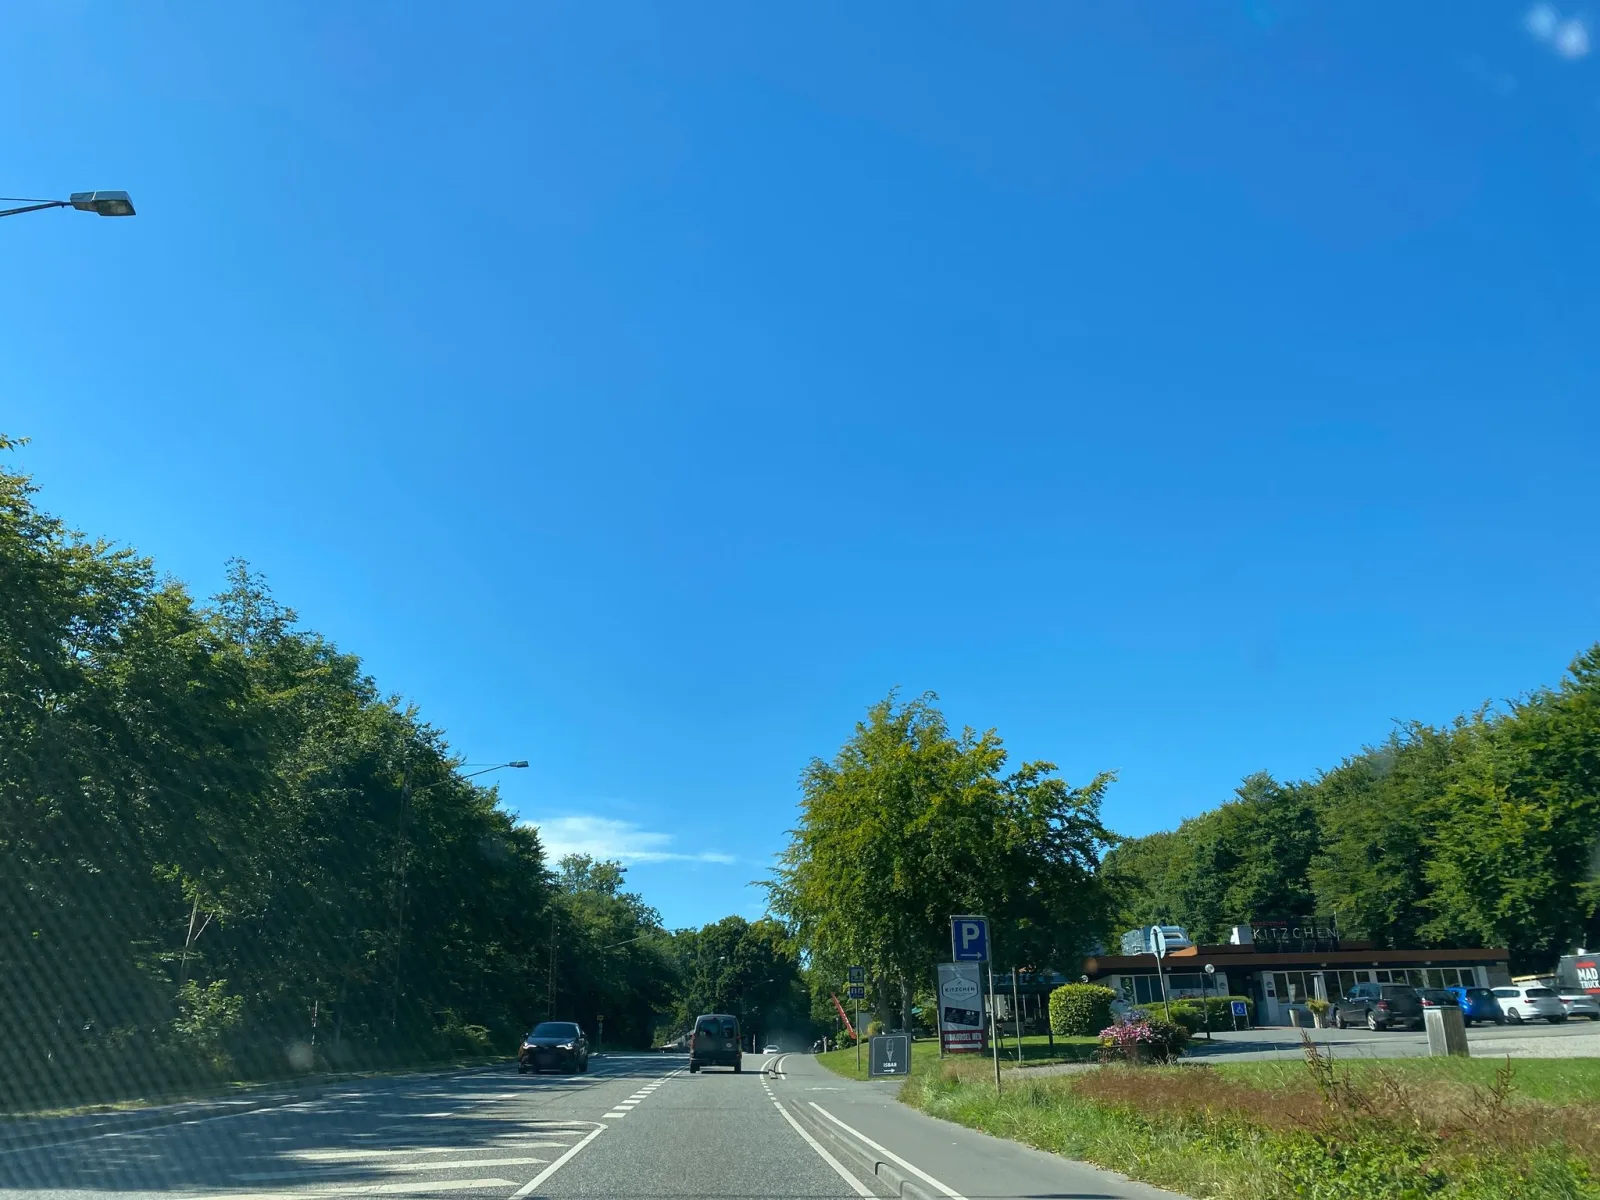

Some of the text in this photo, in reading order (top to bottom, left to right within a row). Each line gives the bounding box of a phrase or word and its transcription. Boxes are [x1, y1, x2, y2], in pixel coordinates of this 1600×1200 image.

[962, 923, 980, 949] P
[1253, 927, 1337, 939] KITZCHEN
[1577, 967, 1598, 980] MAD
[1580, 979, 1600, 989] TRUCK
